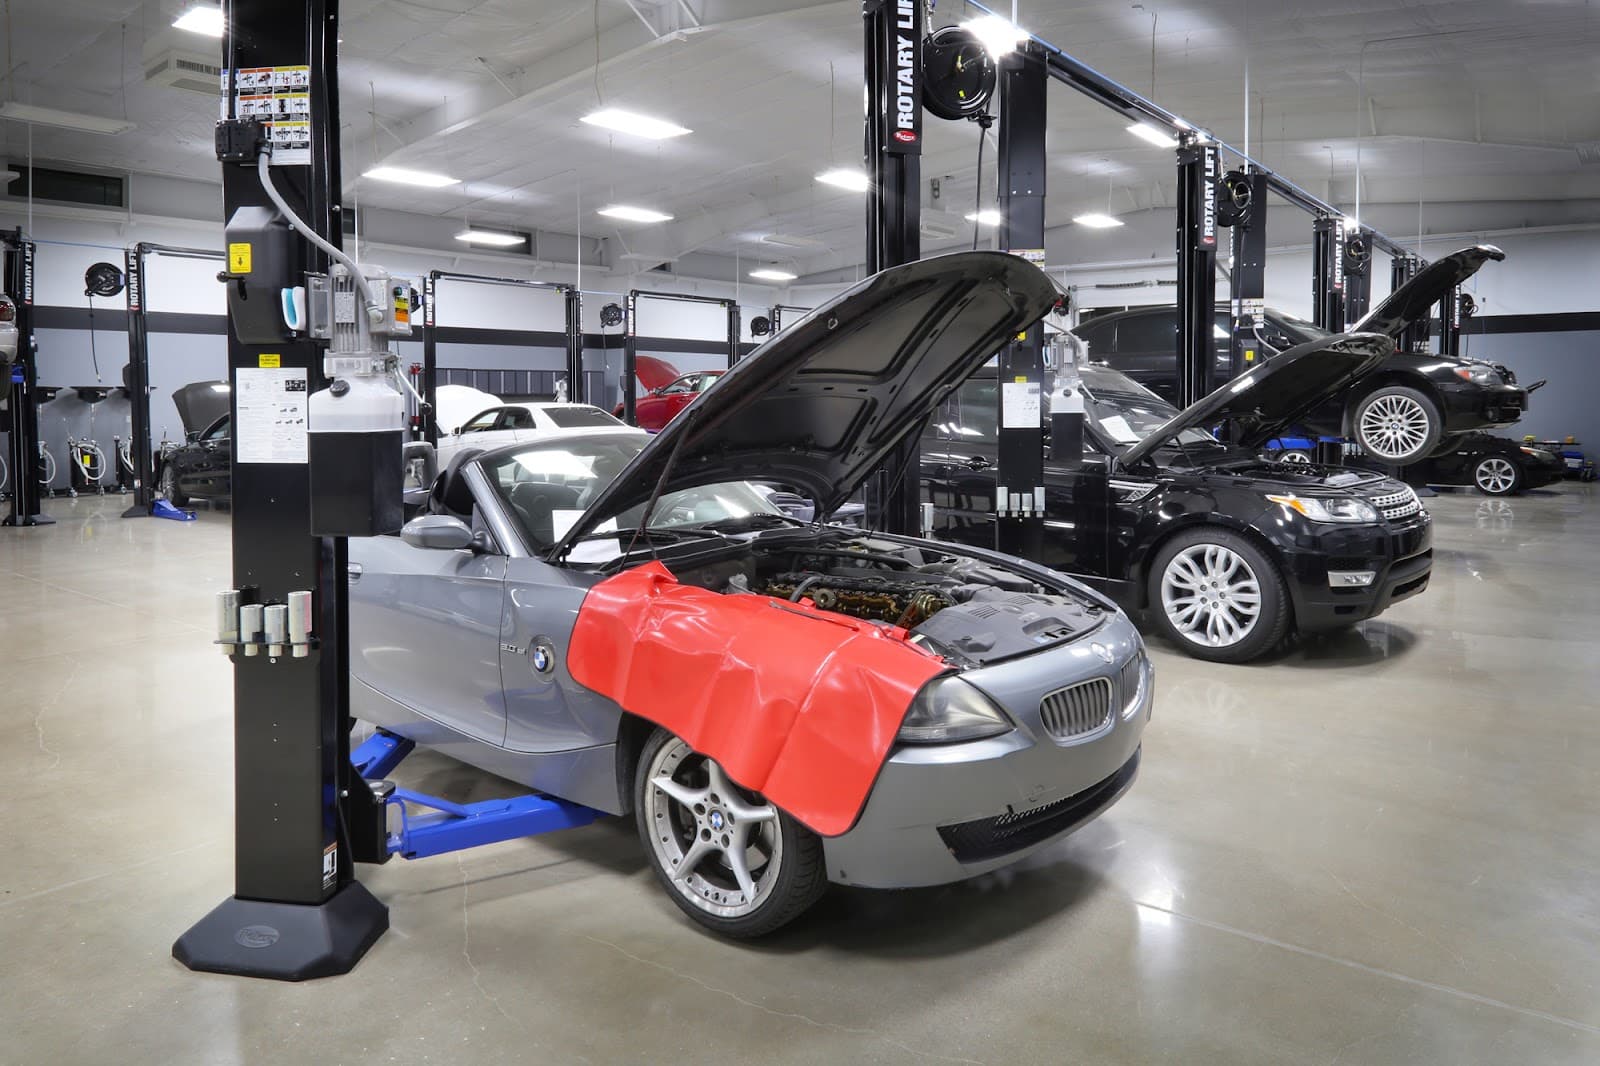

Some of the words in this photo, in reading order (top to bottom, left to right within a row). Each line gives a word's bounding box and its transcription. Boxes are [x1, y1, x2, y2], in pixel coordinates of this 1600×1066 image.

[897, 0, 913, 29] LIF
[897, 35, 913, 129] ROTARY
[1205, 147, 1215, 177] LIFT
[1204, 181, 1214, 237] ROTARY
[25, 243, 33, 262] LIFT
[129, 251, 137, 270] LIFT
[130, 271, 138, 306] ROTARY
